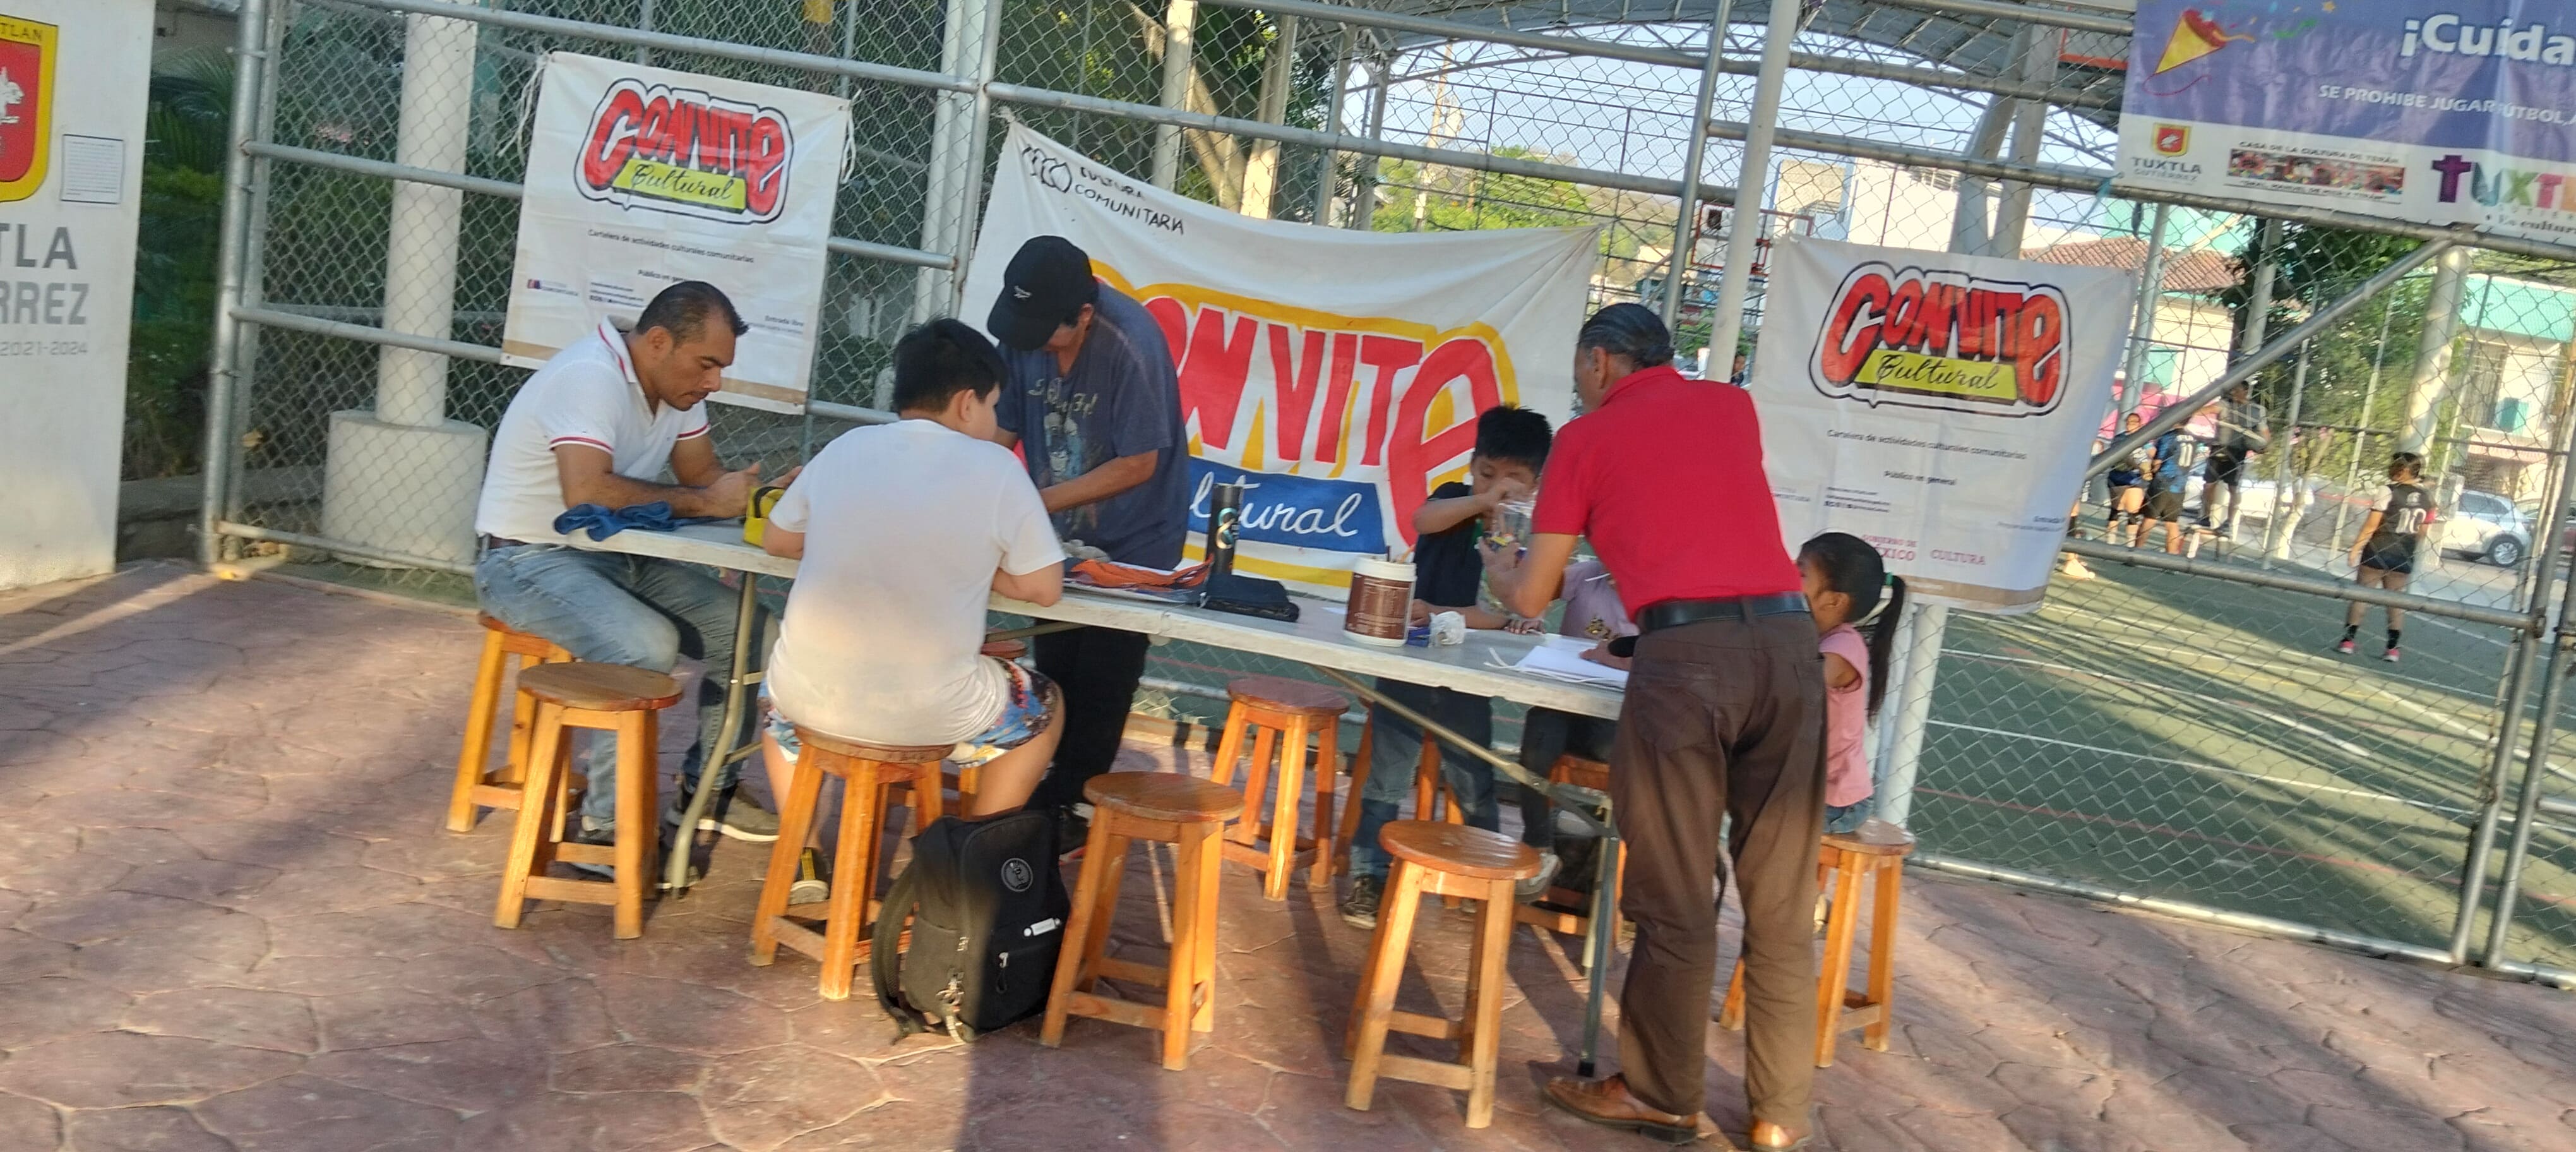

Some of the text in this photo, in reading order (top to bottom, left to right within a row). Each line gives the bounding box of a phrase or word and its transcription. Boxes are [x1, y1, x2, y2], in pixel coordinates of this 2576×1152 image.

[2318, 85, 2341, 99] SE
[2344, 87, 2428, 108] PROHIBE
[2430, 97, 2496, 113] JUGAR
[2131, 157, 2202, 174] TUXTLA
[631, 164, 733, 200] Cultural
[1080, 166, 1145, 201] CULTURA
[1075, 184, 1184, 236] COMUNITARIA
[1876, 354, 1998, 390] Cultural
[2395, 507, 2427, 534] 10
[1875, 543, 1986, 566] XICO CULTURA
